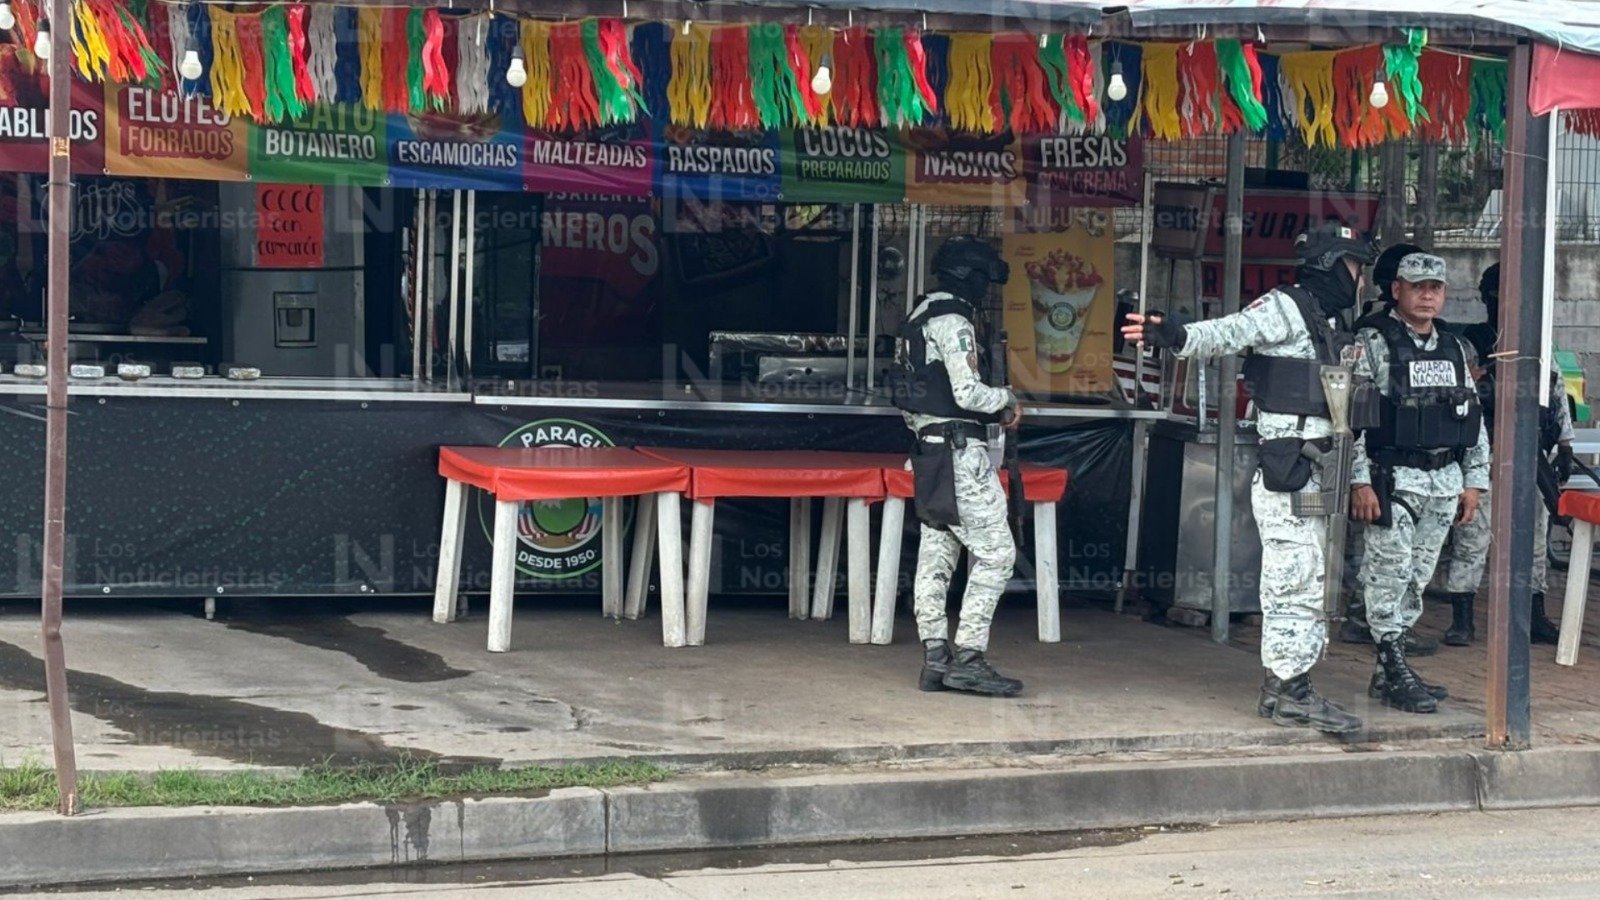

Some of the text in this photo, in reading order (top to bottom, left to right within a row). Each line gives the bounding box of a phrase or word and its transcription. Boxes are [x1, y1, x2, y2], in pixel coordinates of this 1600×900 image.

[128, 126, 234, 157] FORRADOS
[265, 128, 377, 160] BOTANERO
[398, 140, 518, 168] ESCAMOCHAS
[533, 140, 648, 169] MALTEADAS
[803, 126, 891, 158] COCOS
[1040, 137, 1128, 168] FRESAS
[669, 146, 776, 175] RASPADOS
[801, 159, 890, 181] PREPARADOS
[923, 150, 1017, 178] NACHOS
[1072, 171, 1128, 192] CREMA
[1412, 360, 1453, 374] GUARDIA
[1412, 373, 1455, 386] NACIONAL
[517, 549, 596, 569] DESDE 1950
